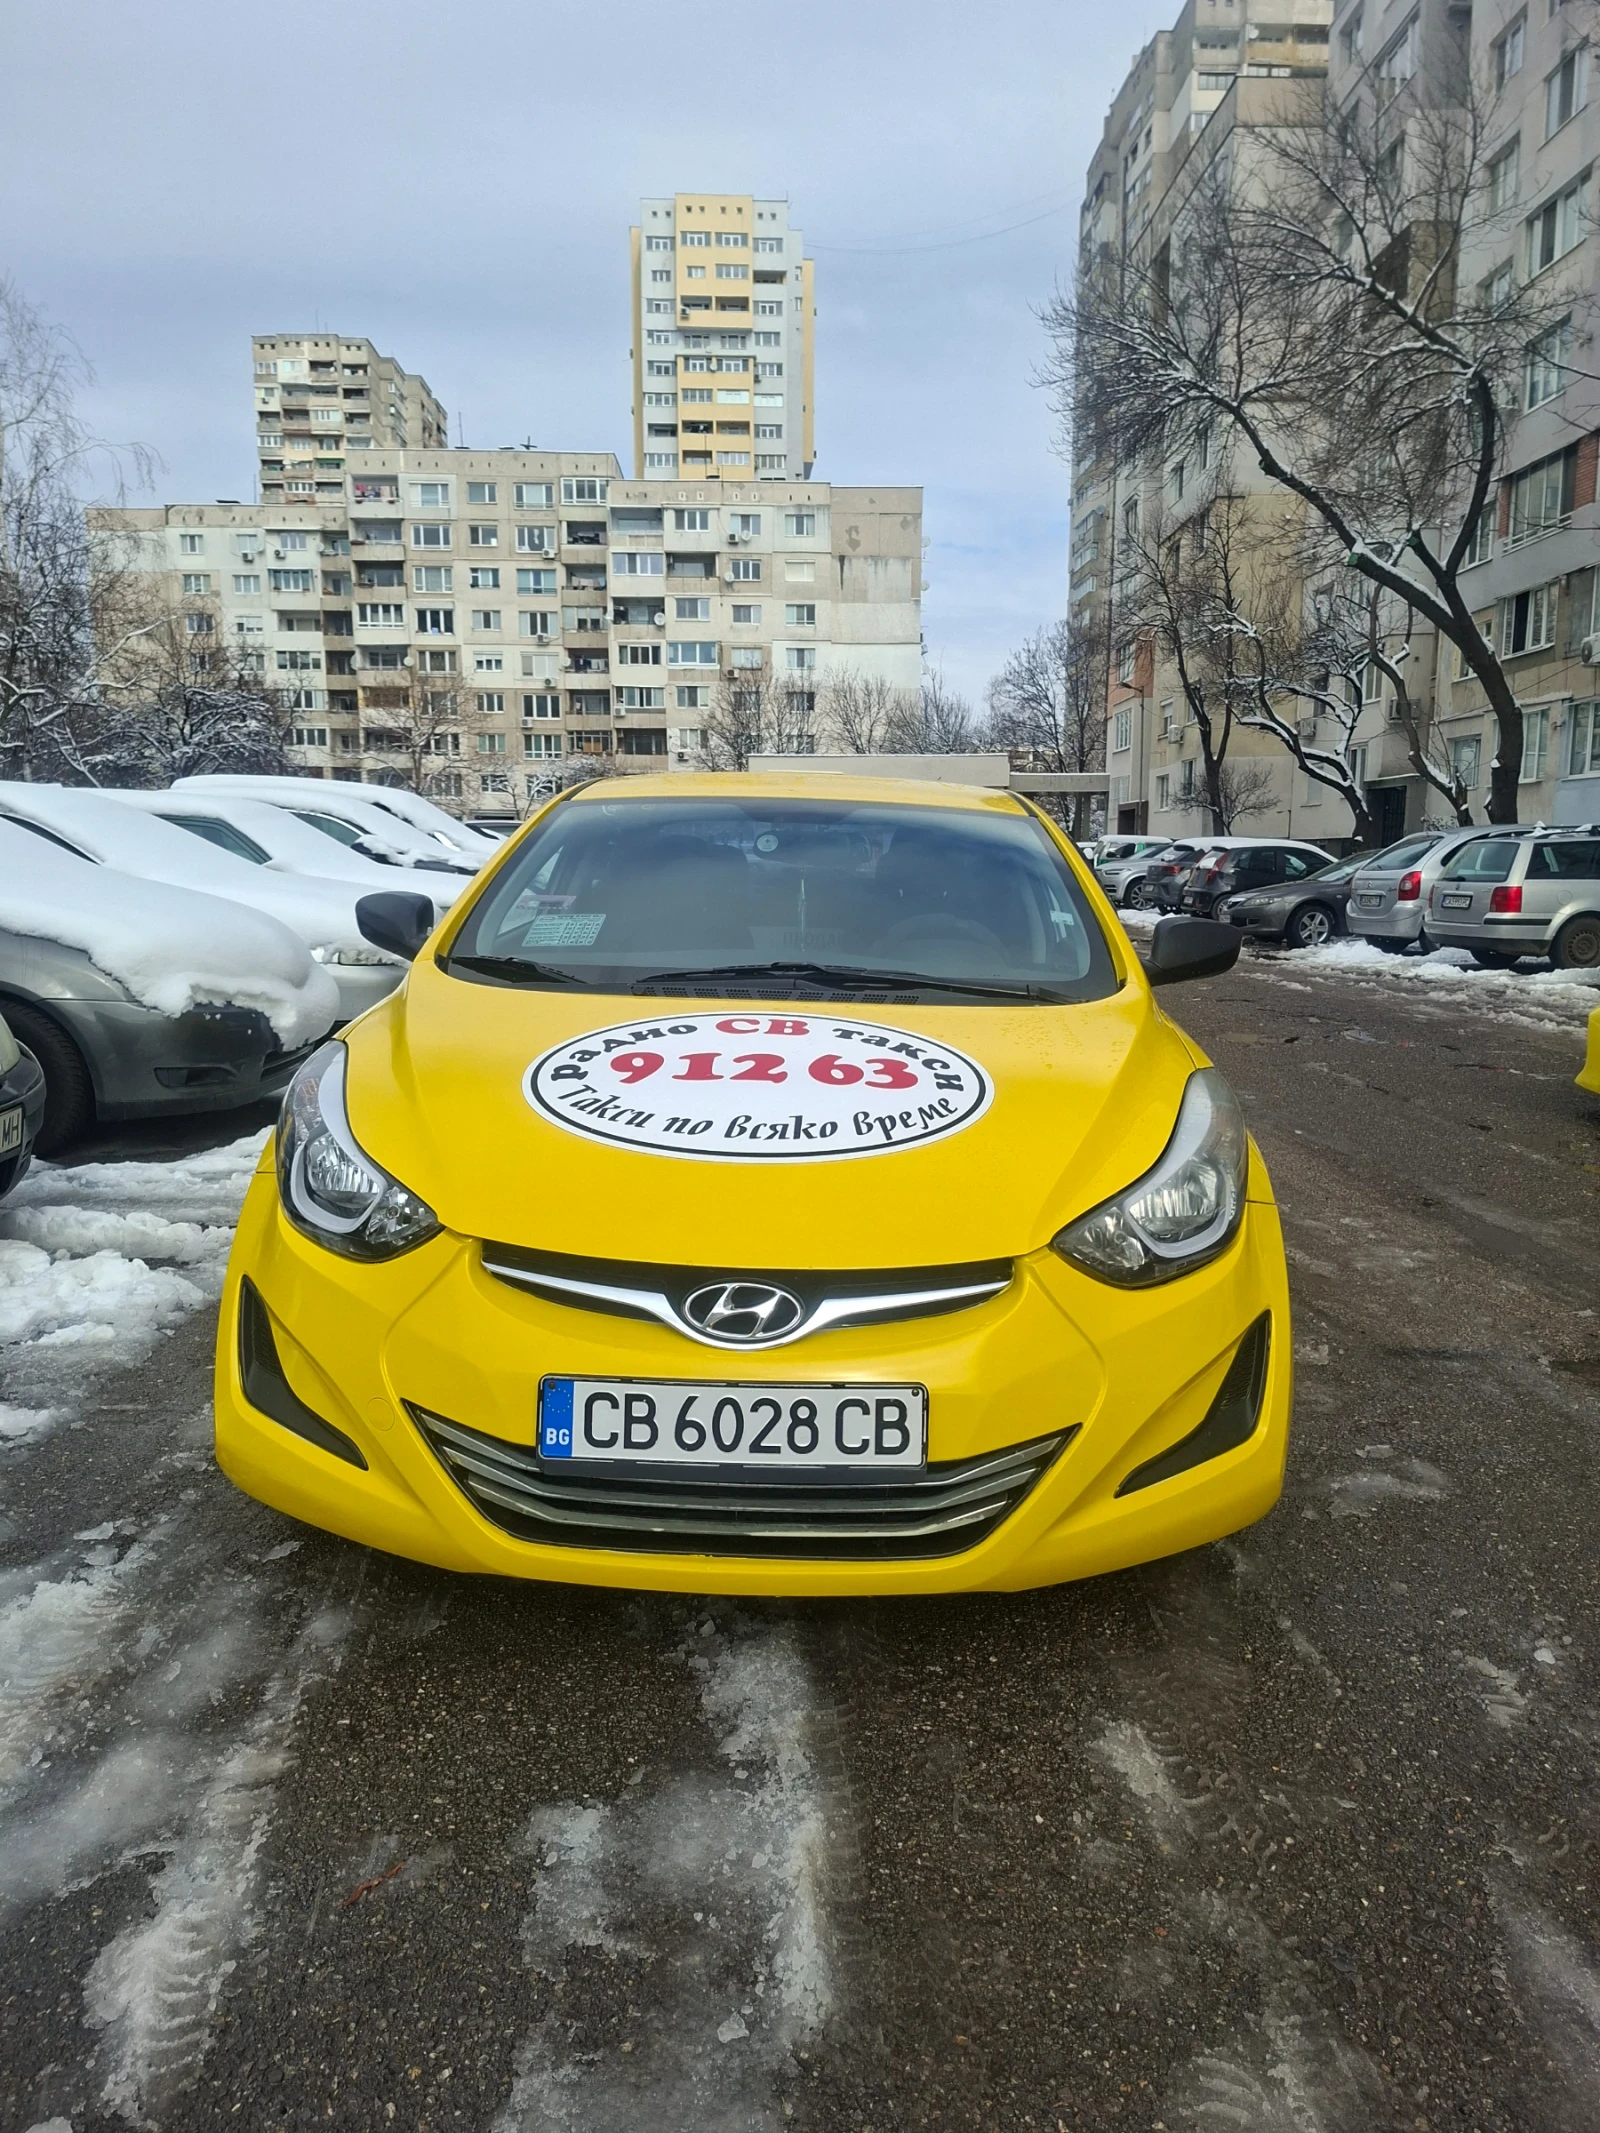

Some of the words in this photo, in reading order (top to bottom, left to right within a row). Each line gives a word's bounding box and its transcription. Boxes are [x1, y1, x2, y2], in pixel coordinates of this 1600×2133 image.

[551, 1024, 698, 1081] радио
[832, 1028, 964, 1091] такси
[558, 1085, 655, 1128] Такси
[663, 1116, 714, 1136] по
[724, 1114, 838, 1140] всяко
[853, 1097, 958, 1141] време
[546, 1427, 570, 1445] BG
[583, 1392, 658, 1450] CB
[674, 1396, 818, 1454] 6028
[835, 1398, 910, 1455] CB
